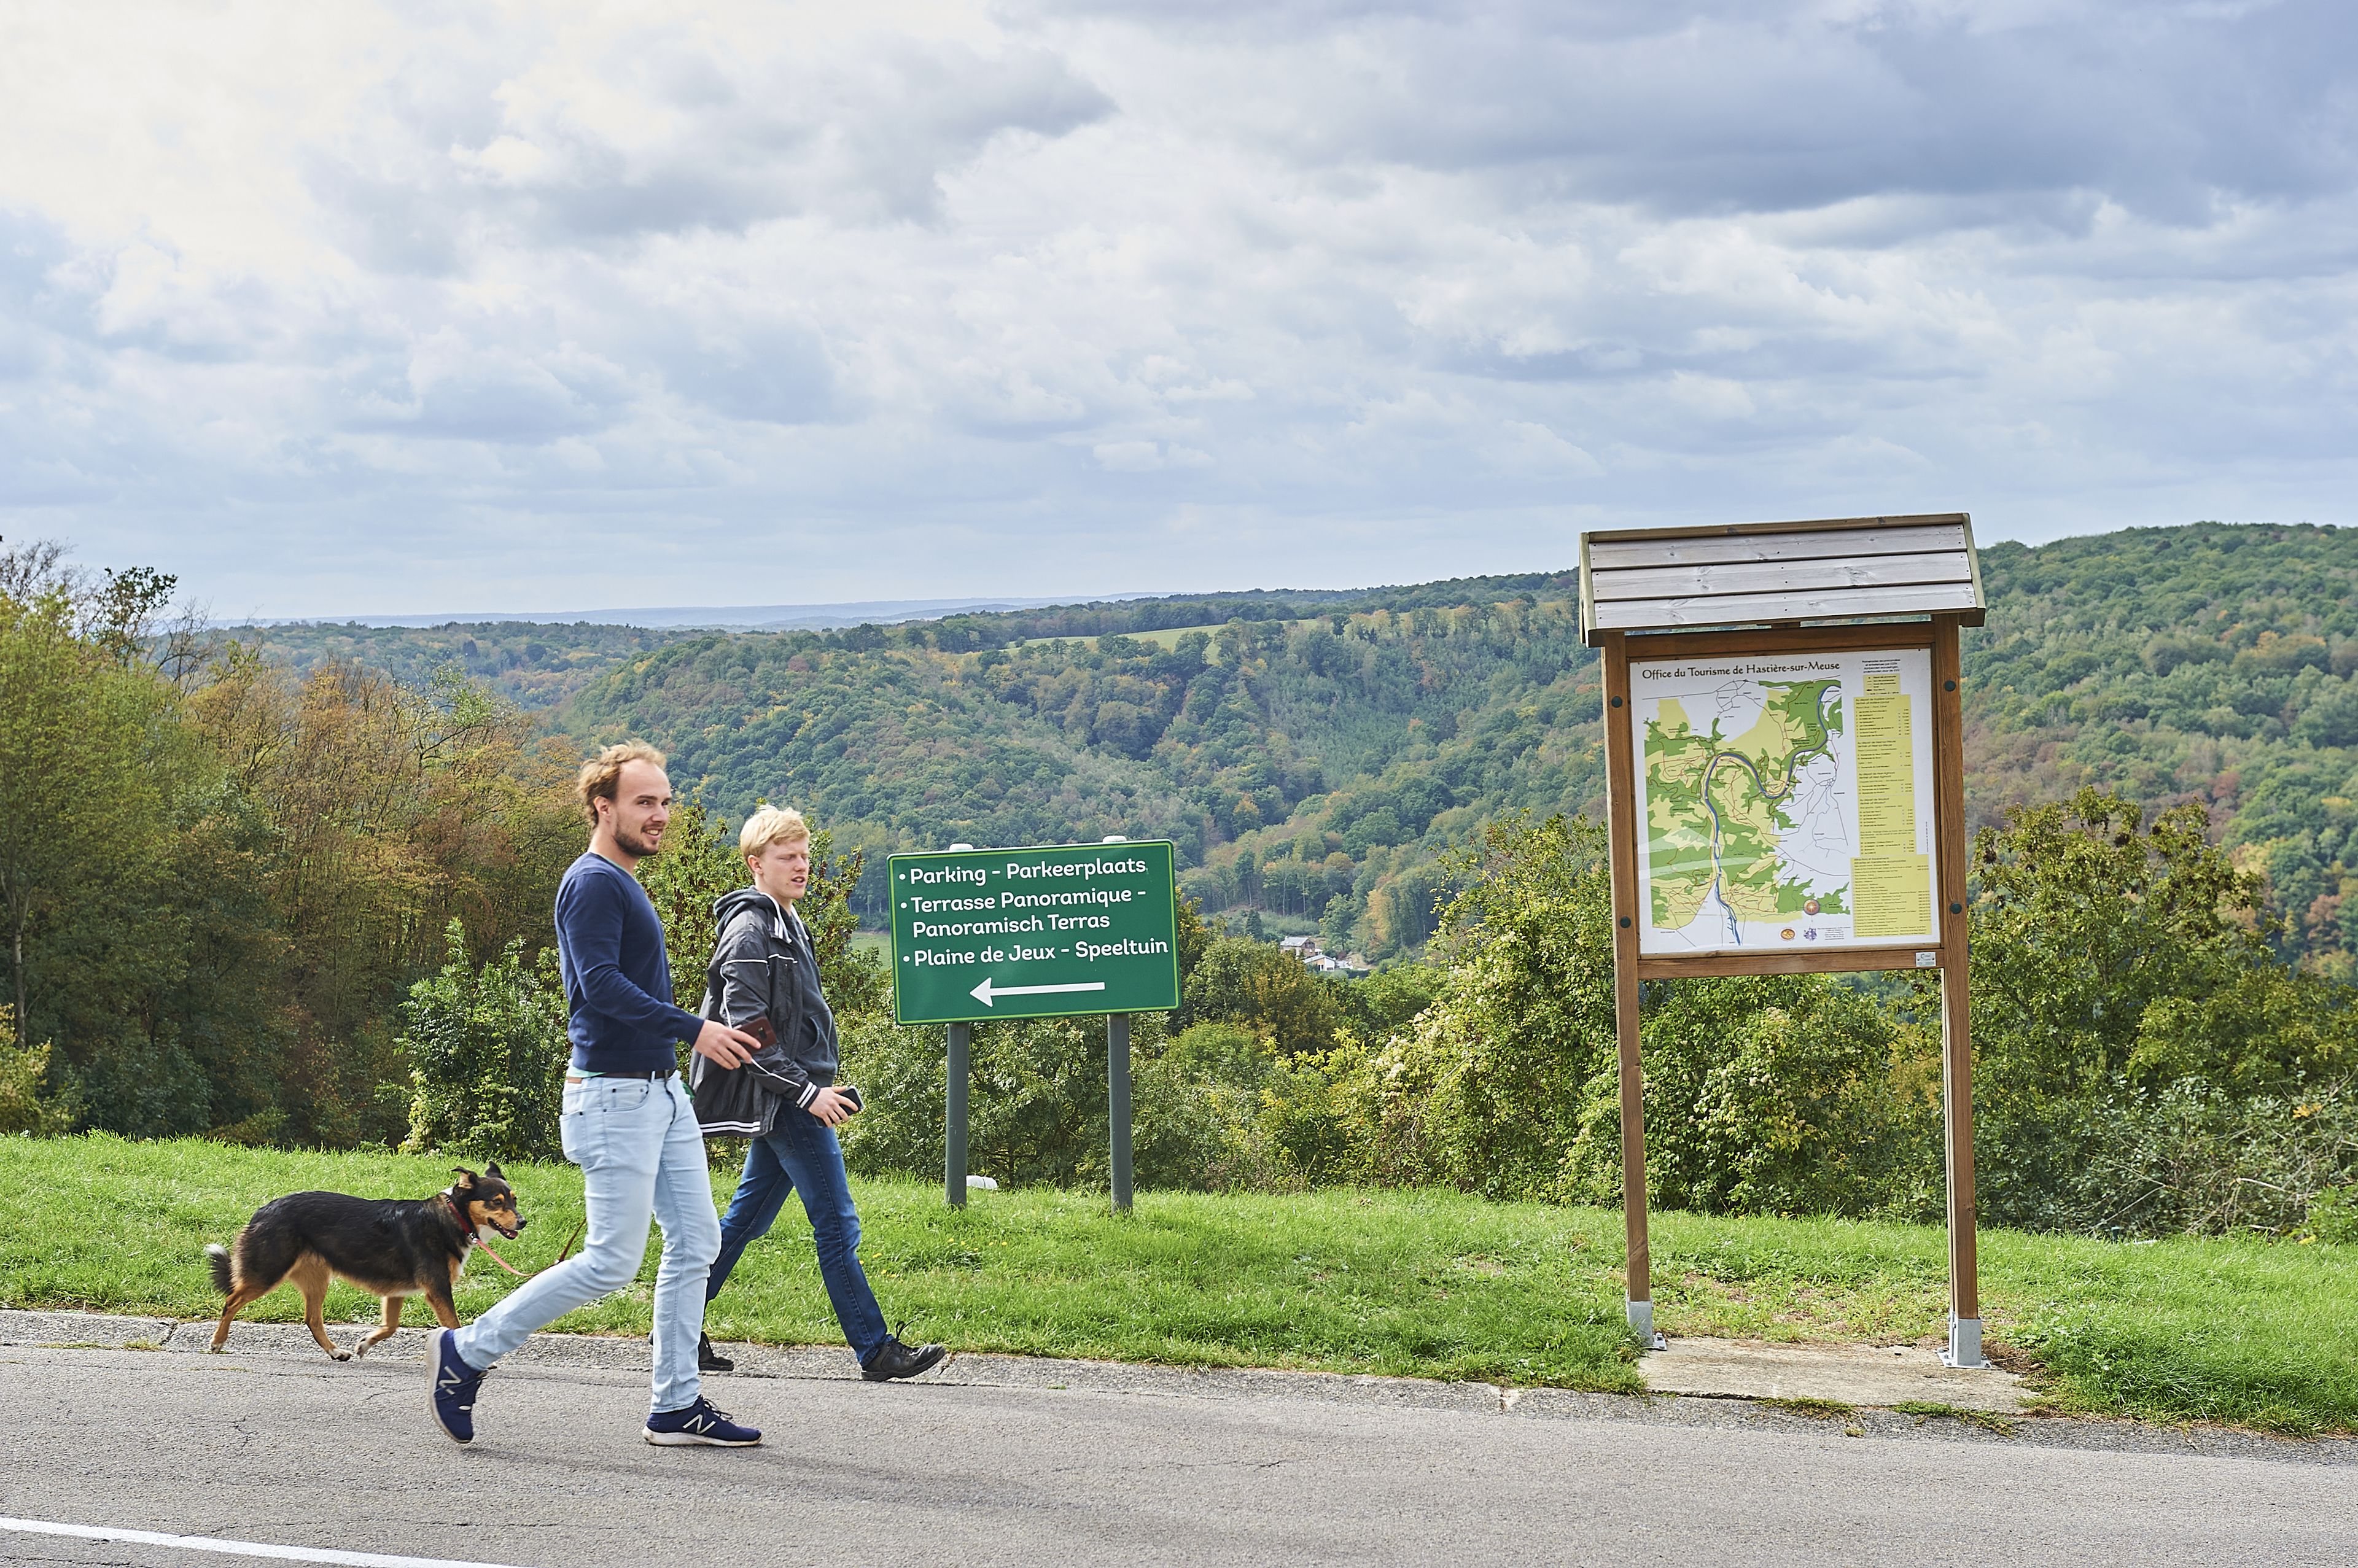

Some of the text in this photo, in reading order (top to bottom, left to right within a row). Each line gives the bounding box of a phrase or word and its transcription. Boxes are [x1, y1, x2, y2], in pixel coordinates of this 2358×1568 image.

[1642, 661, 1840, 680] Office du Tourisme de Hastière-sur-Meuse
[910, 866, 986, 887] Parking
[1006, 858, 1146, 880] Parkeerplaats
[910, 897, 995, 914] Terrasse
[1001, 887, 1132, 909] Panoramique
[912, 914, 1110, 938] Panoramisch Terras
[914, 949, 975, 967] Plaine
[980, 945, 1004, 963] de
[1008, 944, 1056, 961] Jeux
[1075, 937, 1169, 962] Speeltuin
[682, 1414, 717, 1434] N
